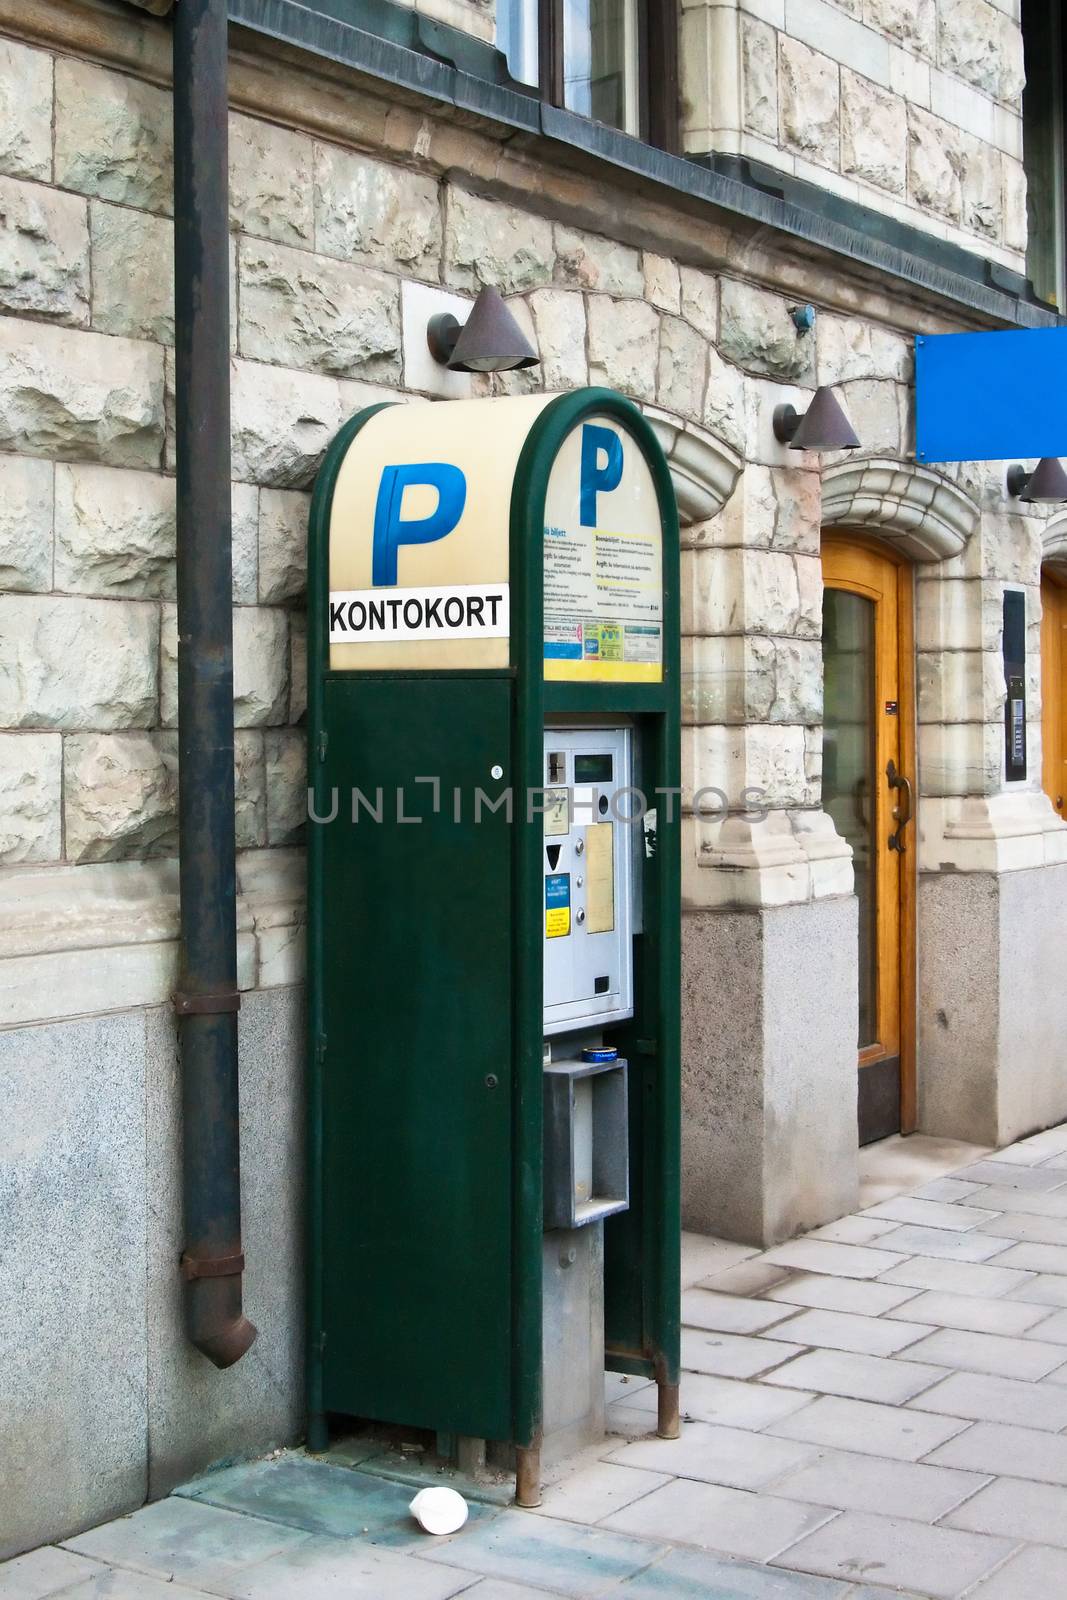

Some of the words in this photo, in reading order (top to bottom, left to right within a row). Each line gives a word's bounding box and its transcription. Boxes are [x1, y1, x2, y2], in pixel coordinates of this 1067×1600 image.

[372, 462, 467, 587] P
[580, 424, 624, 528] P
[330, 594, 503, 632] KONTOKORT
